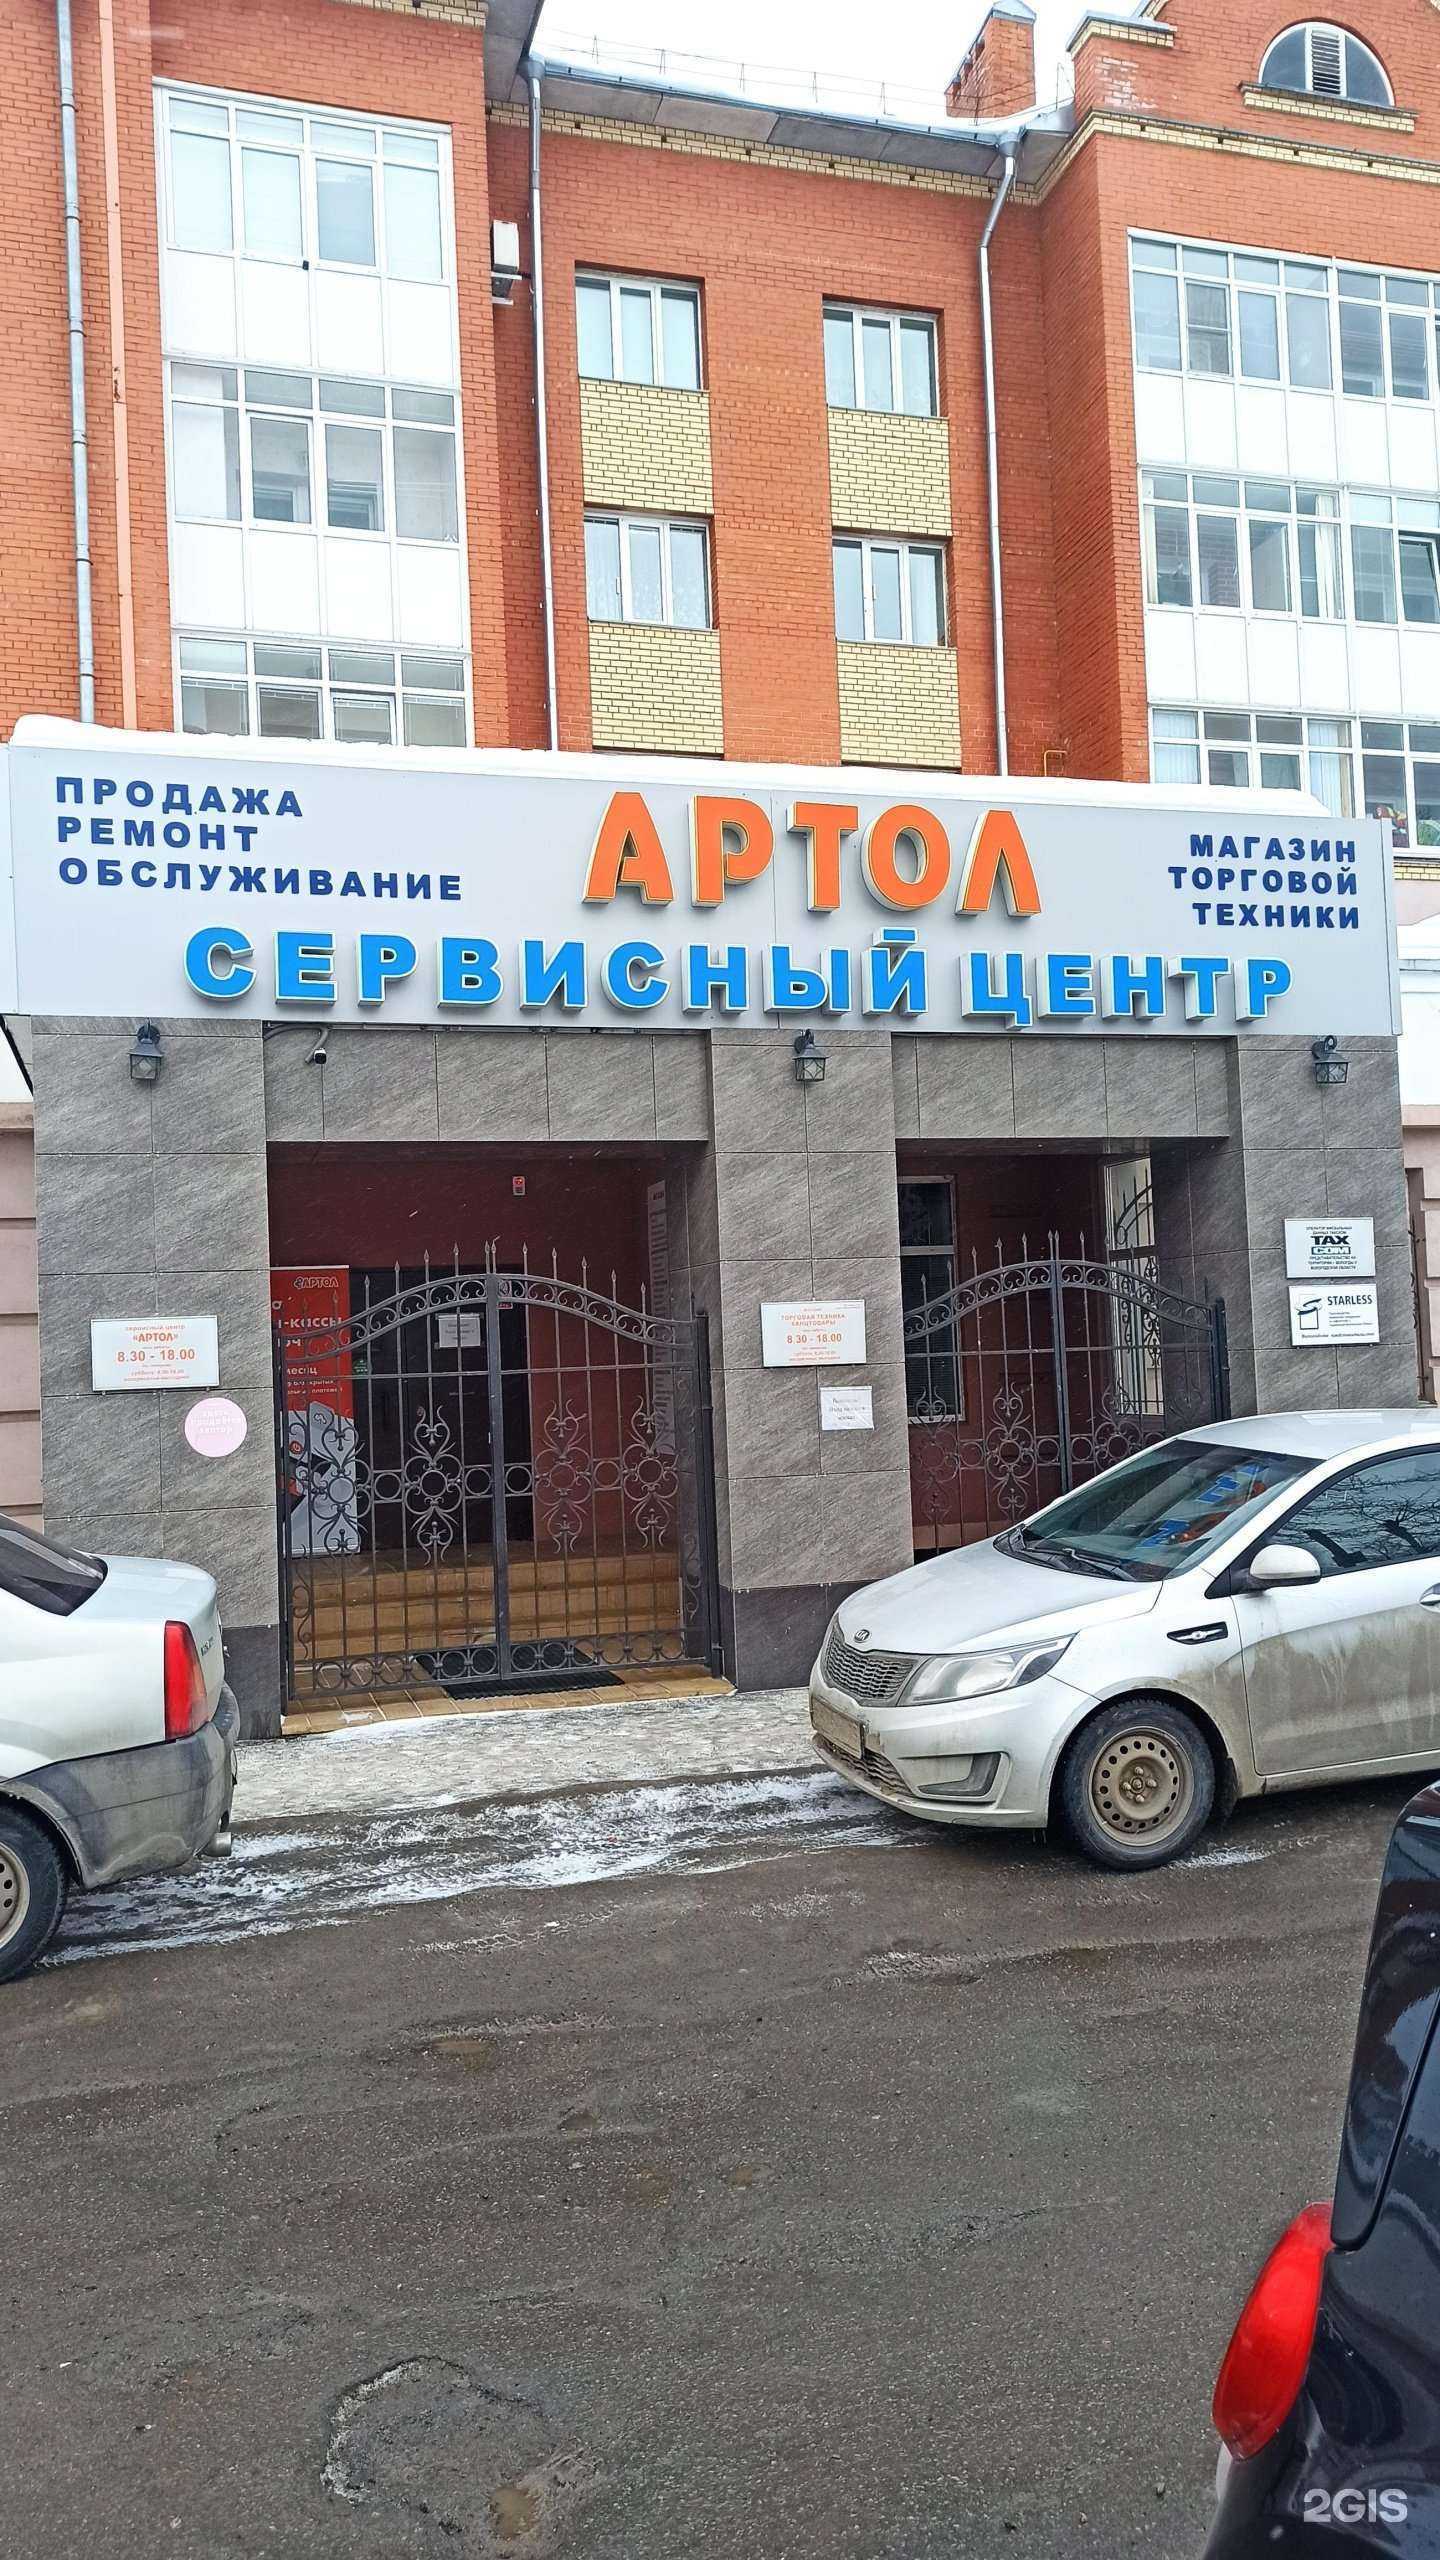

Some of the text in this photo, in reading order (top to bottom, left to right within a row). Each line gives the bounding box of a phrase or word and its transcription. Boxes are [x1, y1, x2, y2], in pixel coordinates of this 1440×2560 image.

[56, 776, 303, 817] ПРОДАЖА
[57, 815, 258, 852] РЕМОНТ
[1189, 833, 1357, 864] МАГАЗИН
[583, 790, 1042, 917] АРТОЛ
[59, 857, 462, 901] ОБСЛУЖИВАНИЕ
[1167, 865, 1358, 896] ТОРГОВОЙ
[1192, 901, 1360, 930] ТЕХНИКИ
[184, 925, 1293, 1030] СЕРВИСНЫЙ ЦЕНТР
[1310, 1235, 1350, 1246] TAX
[1327, 1294, 1373, 1306] STARLESS
[117, 1350, 146, 1362] 8.30
[160, 1348, 195, 1361] 18.00
